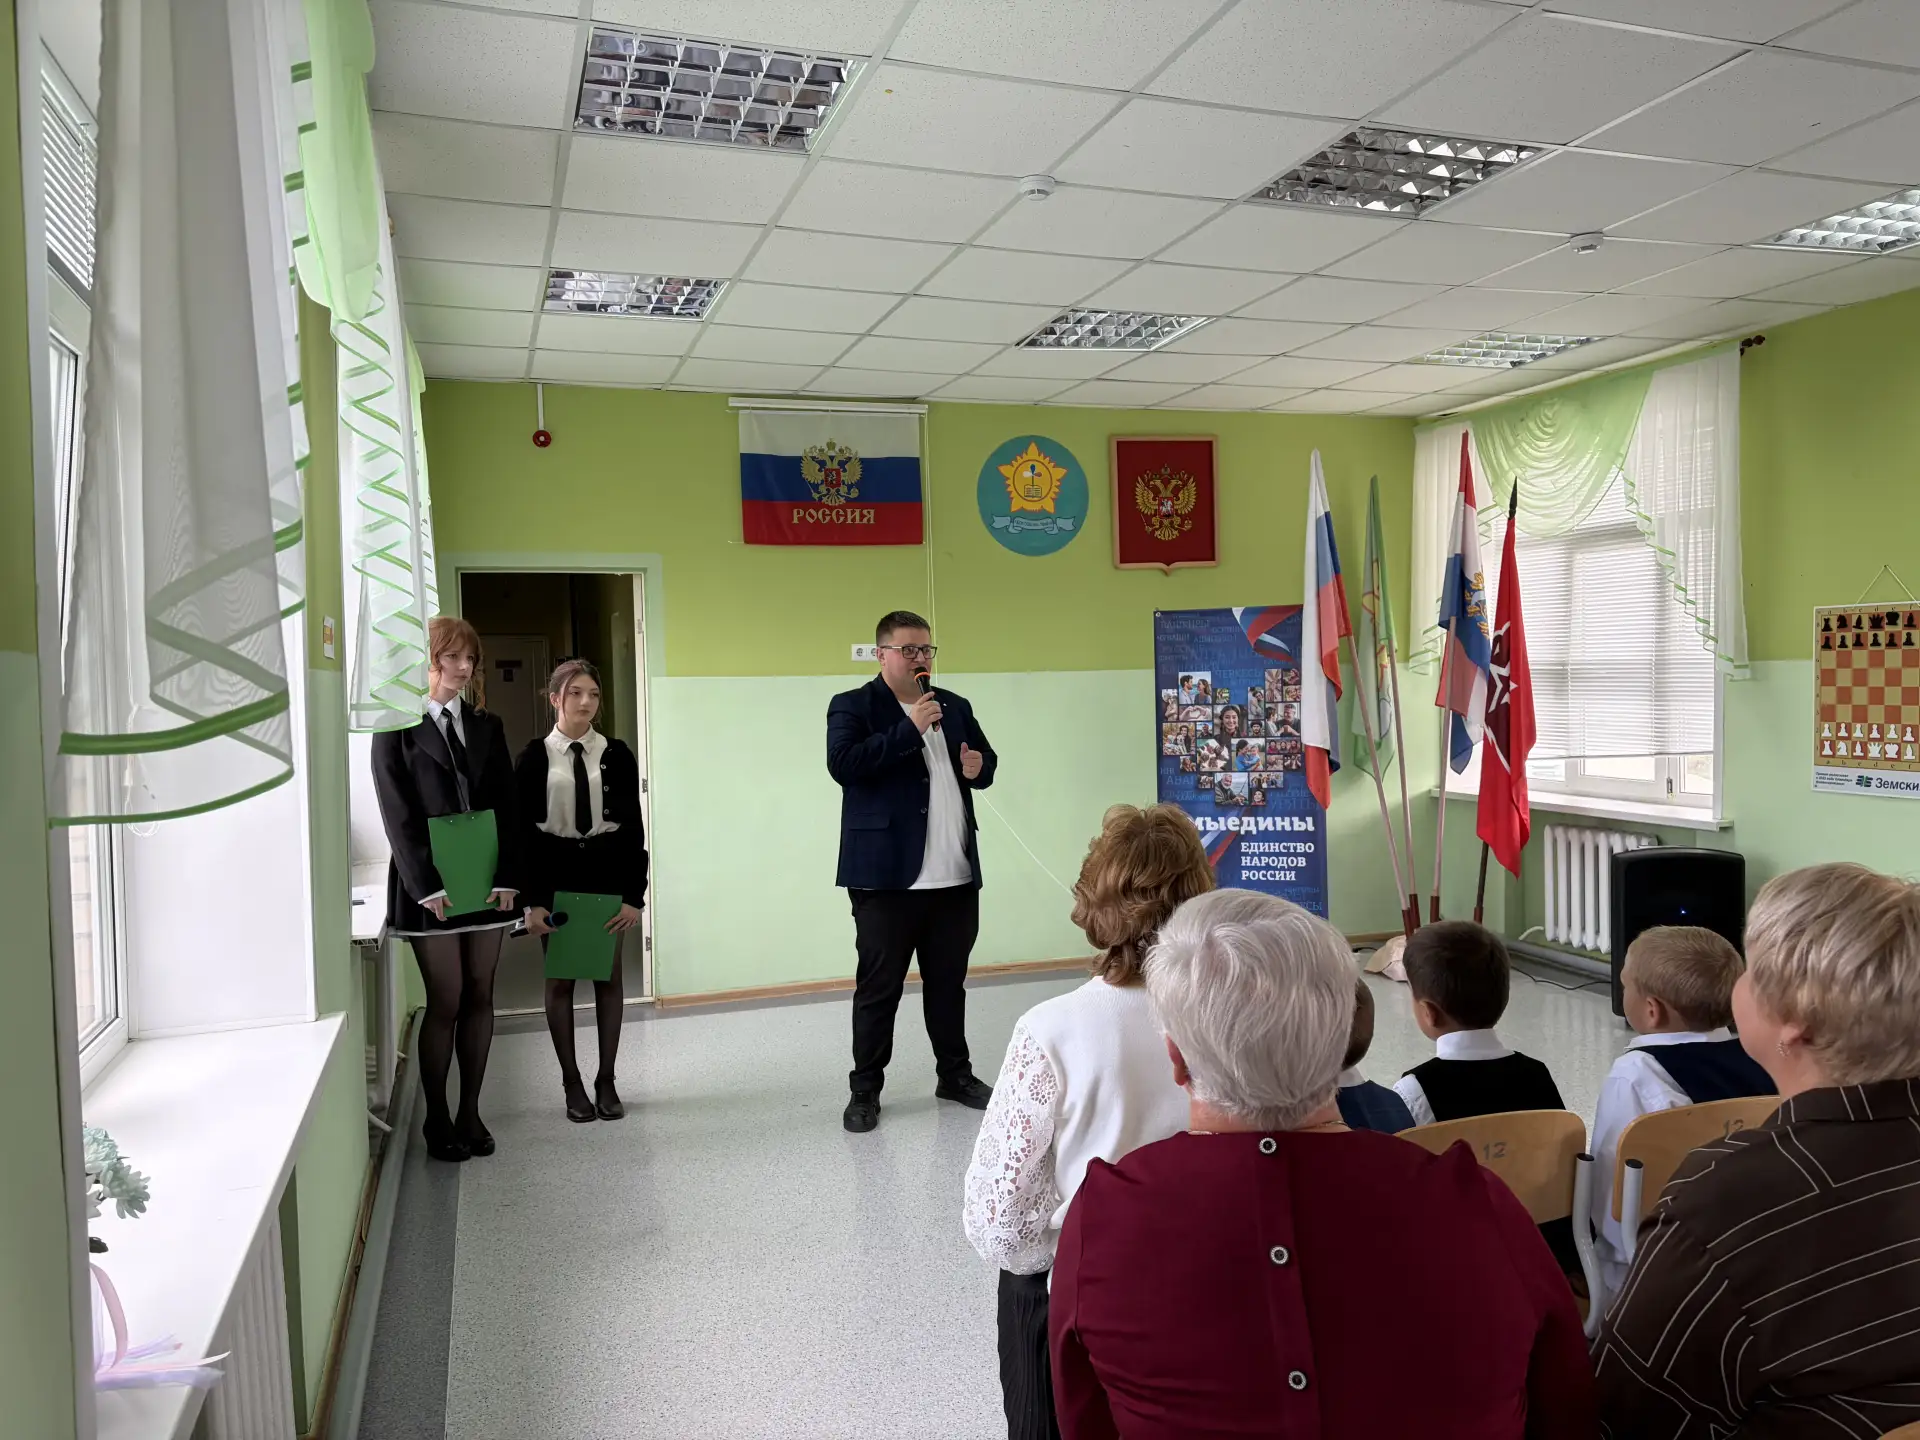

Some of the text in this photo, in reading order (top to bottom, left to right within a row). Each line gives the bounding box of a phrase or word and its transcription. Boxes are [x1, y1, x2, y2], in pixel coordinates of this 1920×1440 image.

[792, 508, 875, 524] РОССИЯ
[1875, 777, 1920, 791] Земски
[1240, 842, 1315, 854] ЕДИНСТВО
[1241, 856, 1306, 868] НАРОДОВ
[1241, 870, 1296, 881] РОССИИ
[1483, 1141, 1508, 1160] 12
